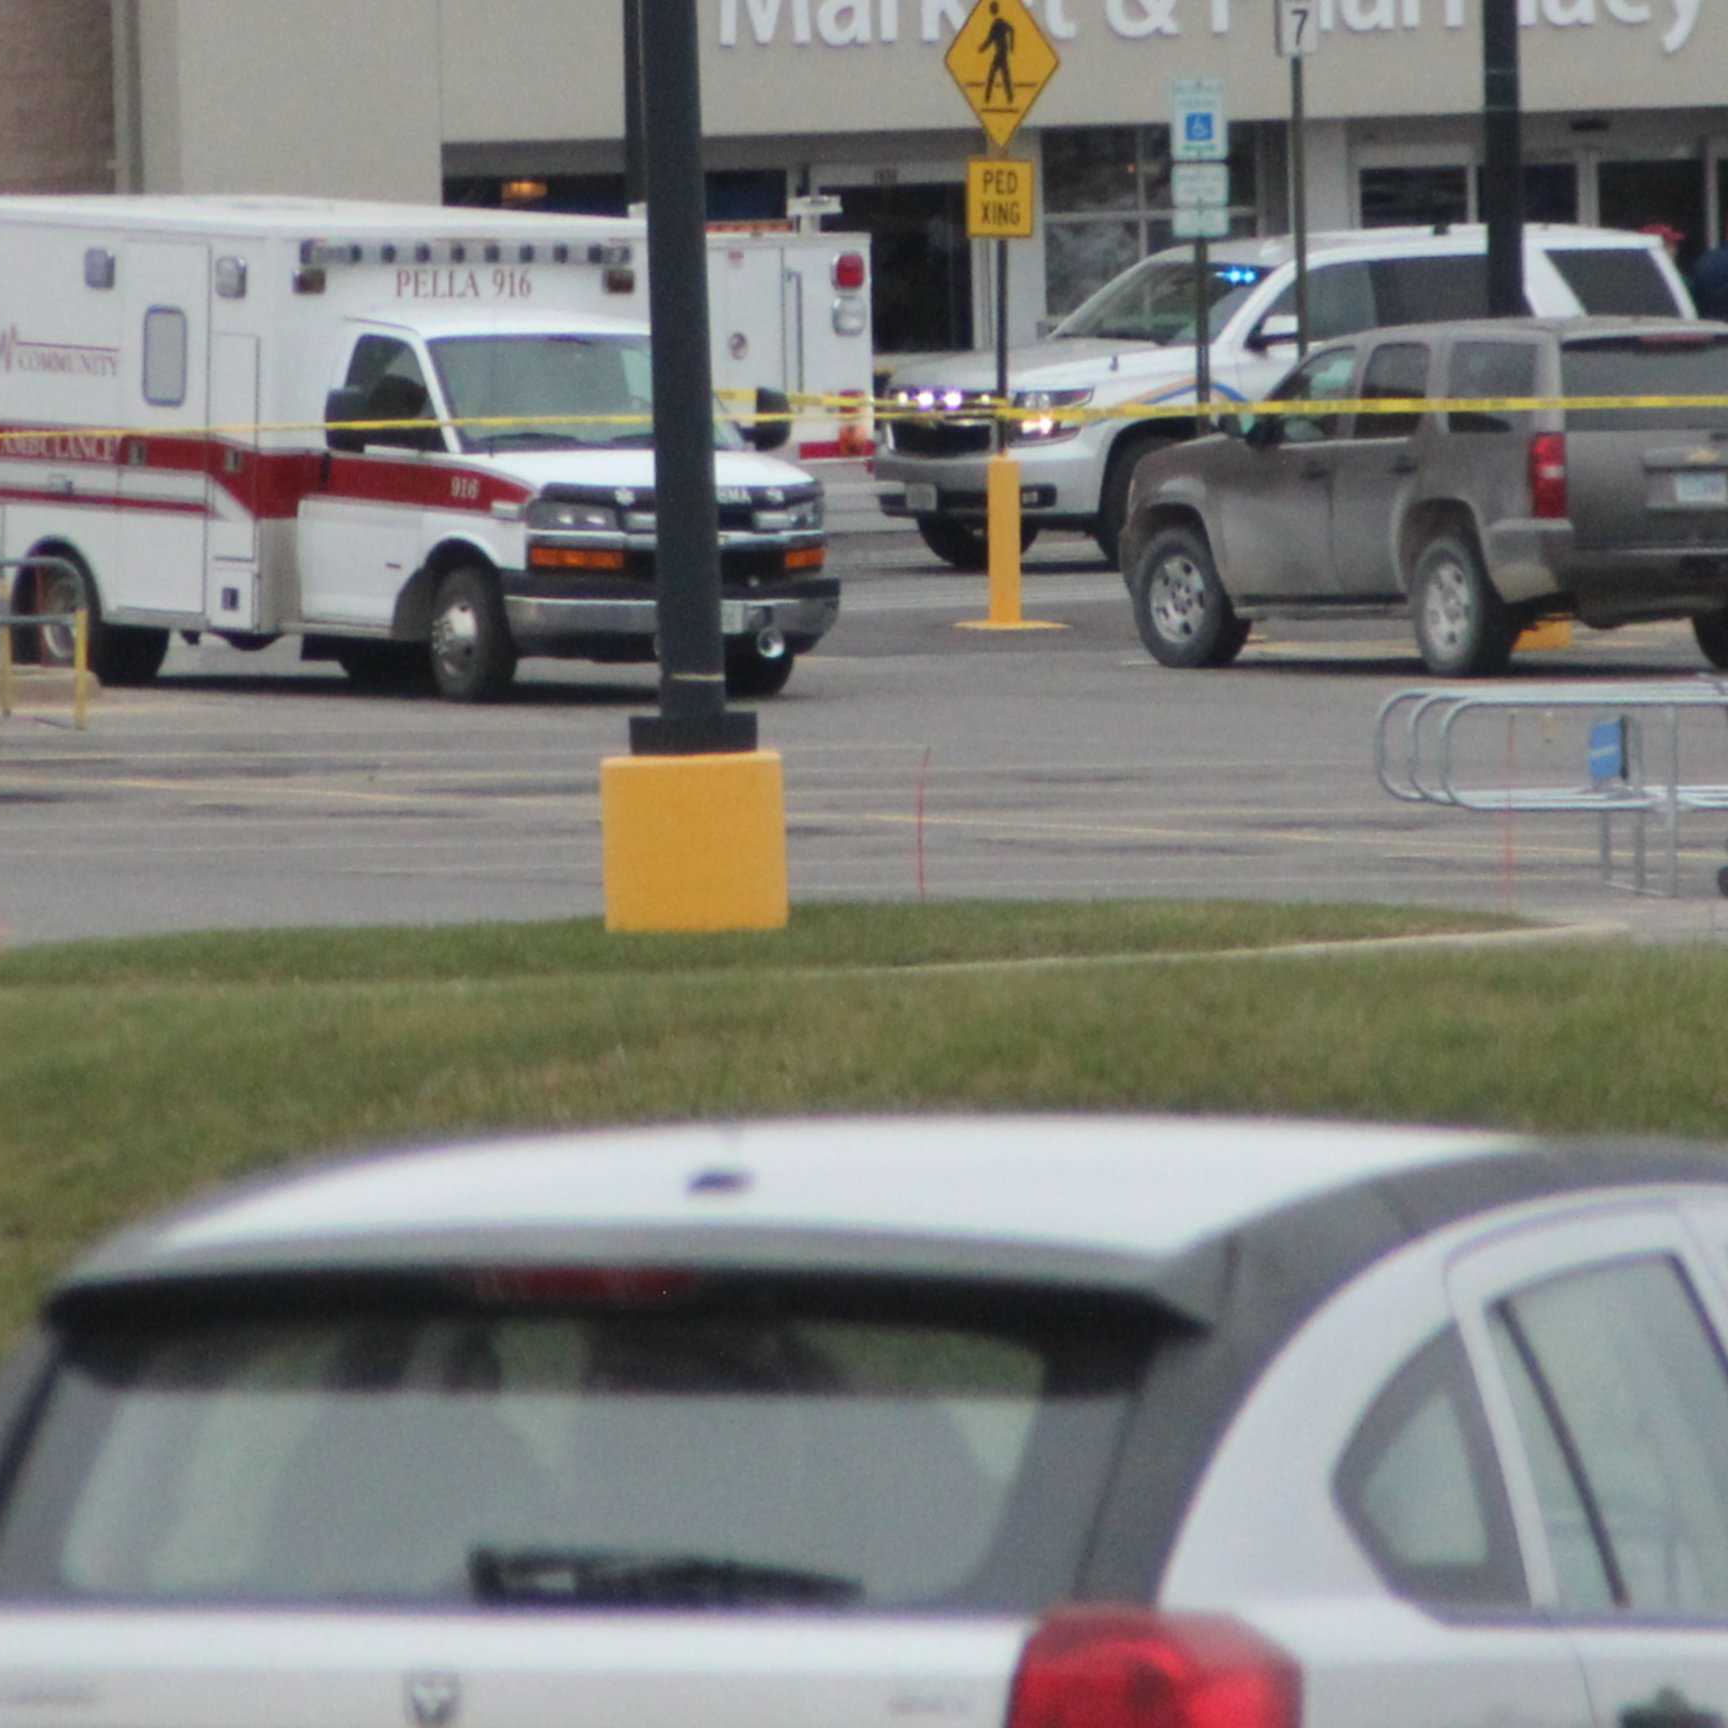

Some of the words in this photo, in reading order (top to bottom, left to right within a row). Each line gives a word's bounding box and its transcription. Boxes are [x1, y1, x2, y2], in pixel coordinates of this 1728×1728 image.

[1291, 8, 1309, 47] 7
[981, 168, 1018, 194] PED
[981, 201, 1021, 226] XING
[395, 269, 480, 298] PELLA
[492, 268, 532, 299] 916
[17, 350, 119, 376] COMMUNITY
[449, 476, 480, 499] 916
